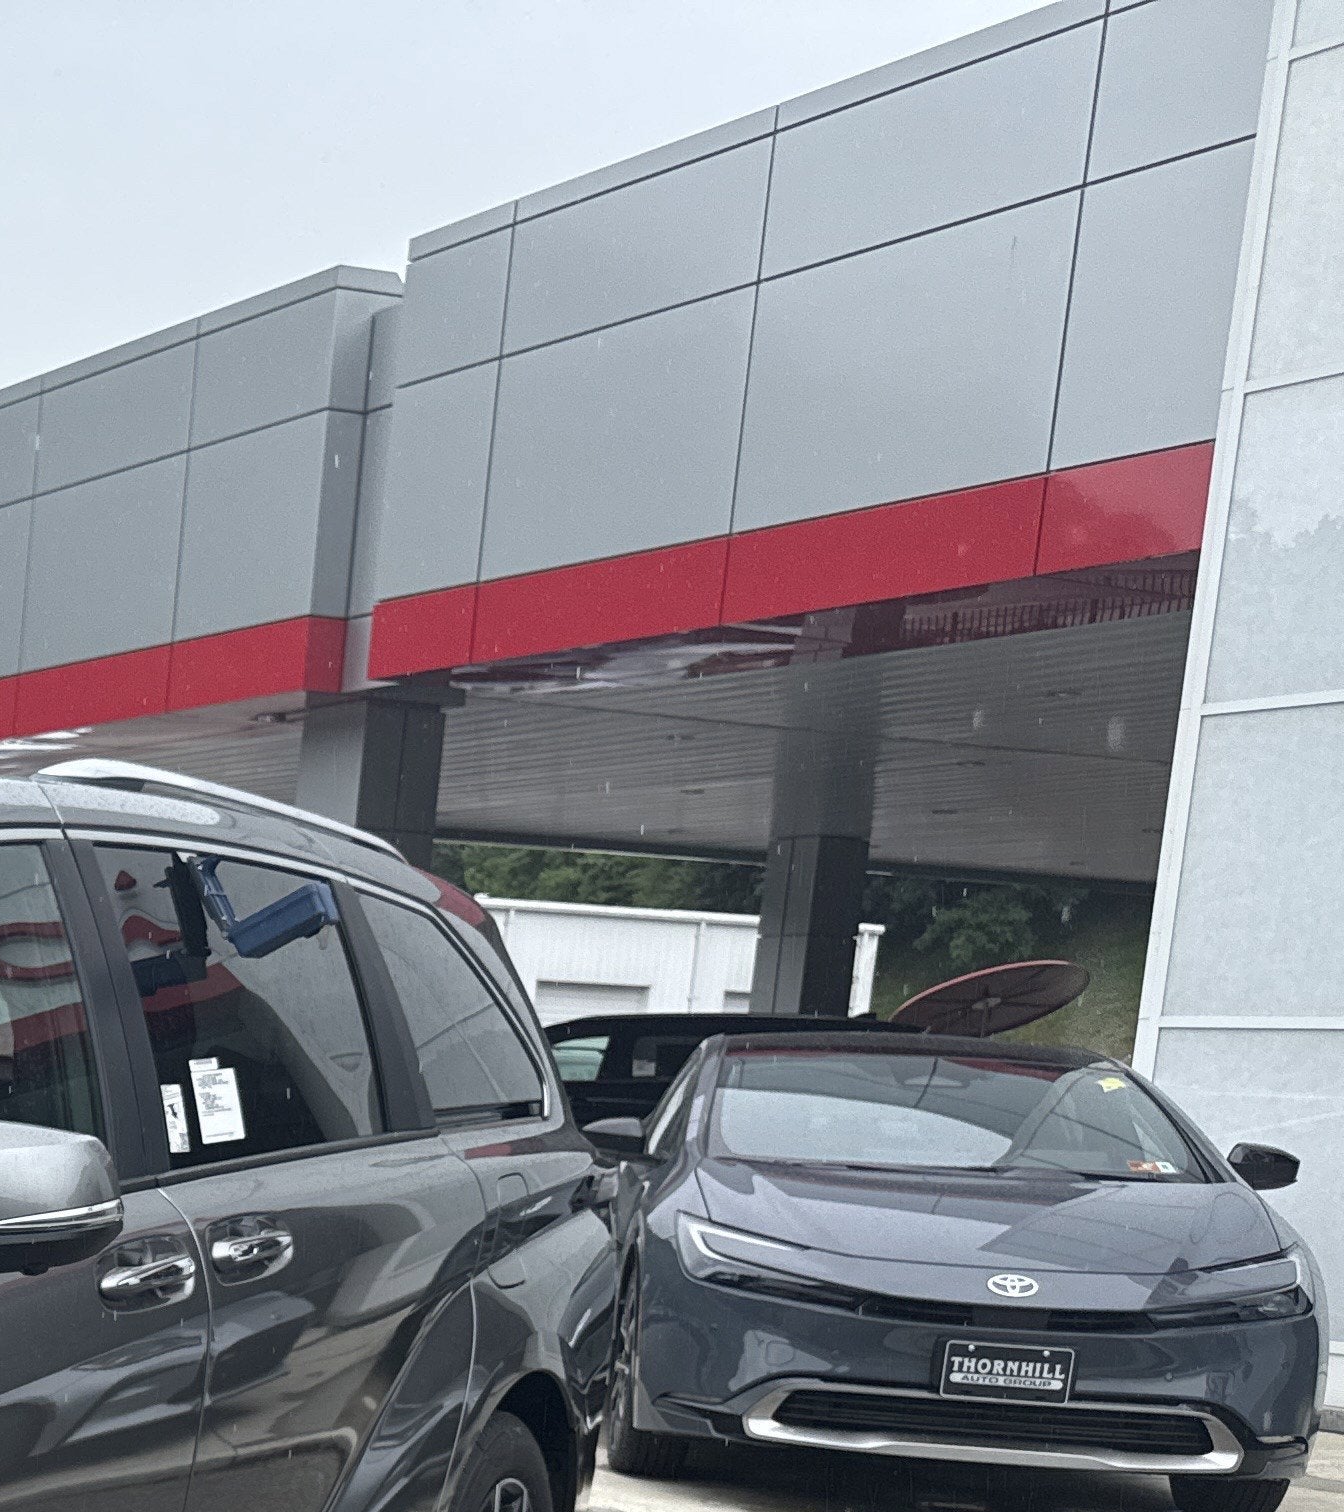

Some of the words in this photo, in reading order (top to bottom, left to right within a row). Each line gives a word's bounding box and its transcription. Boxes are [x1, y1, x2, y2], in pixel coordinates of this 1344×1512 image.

[950, 1356, 1065, 1379] THORNHILL
[962, 1374, 1000, 1385] AUTO
[1003, 1377, 1052, 1388] GROUP
